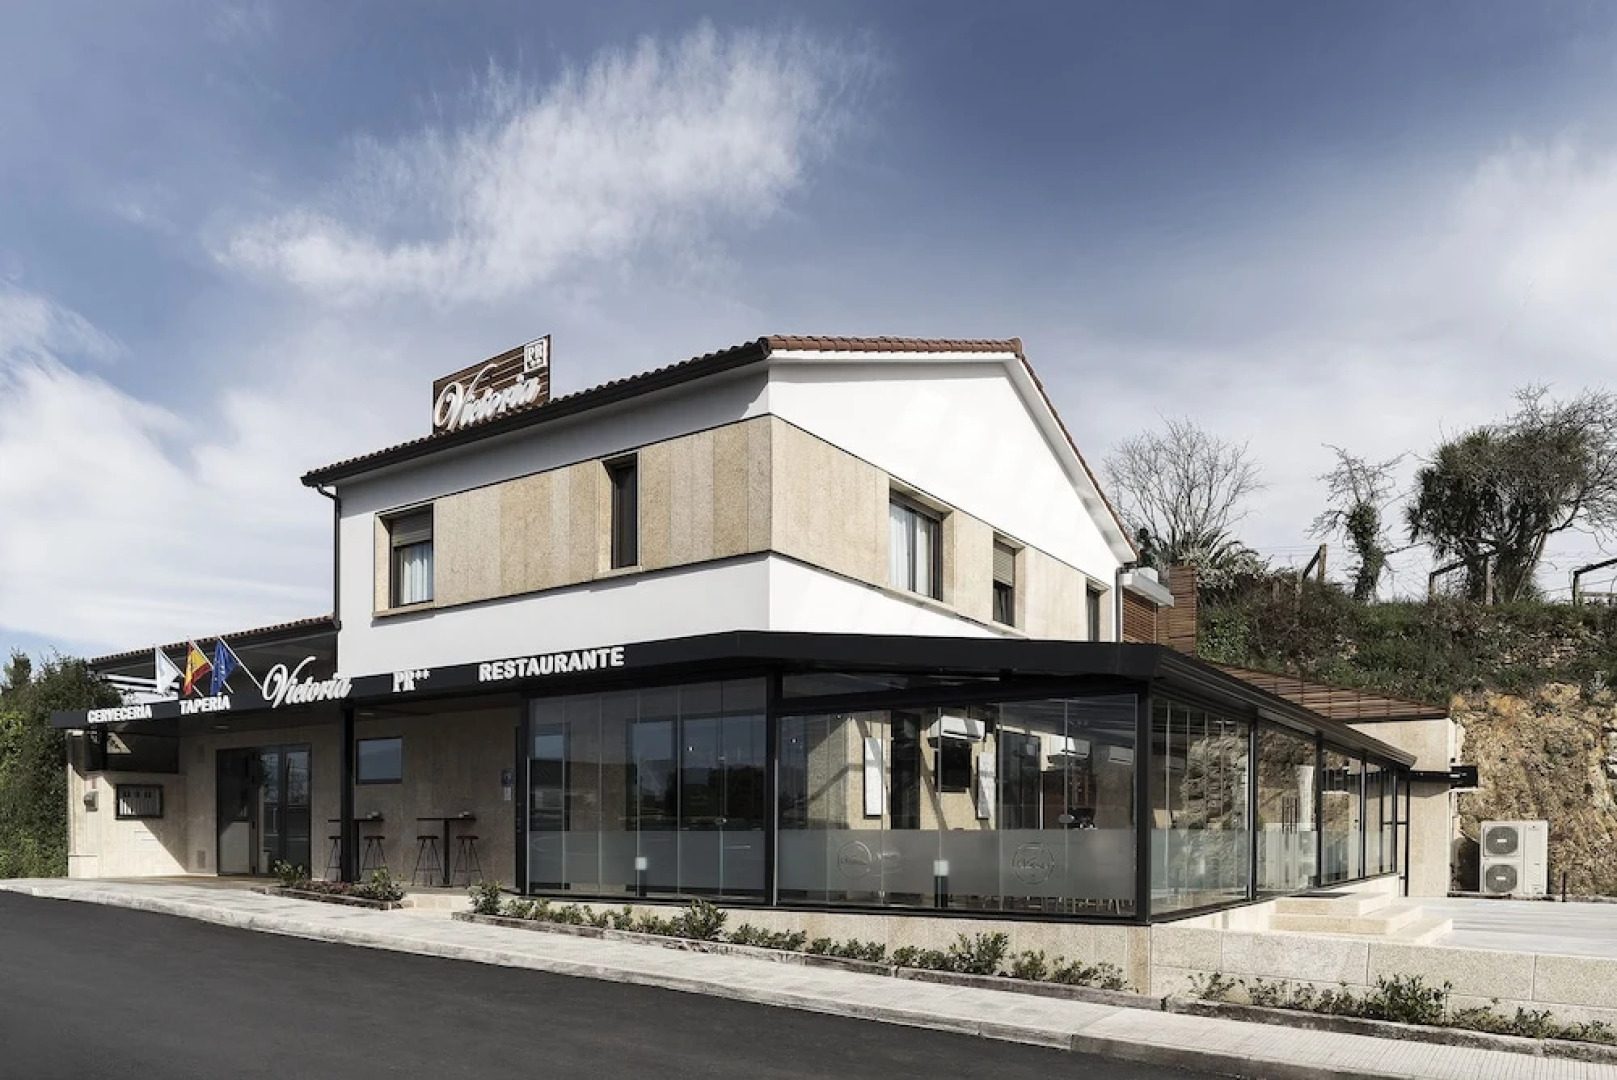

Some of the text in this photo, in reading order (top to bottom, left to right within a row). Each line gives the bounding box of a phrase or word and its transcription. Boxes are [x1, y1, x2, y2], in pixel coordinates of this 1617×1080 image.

[262, 655, 353, 708] Victoria
[478, 646, 625, 682] RESTAURANTE
[178, 692, 231, 715] TAPERÍA
